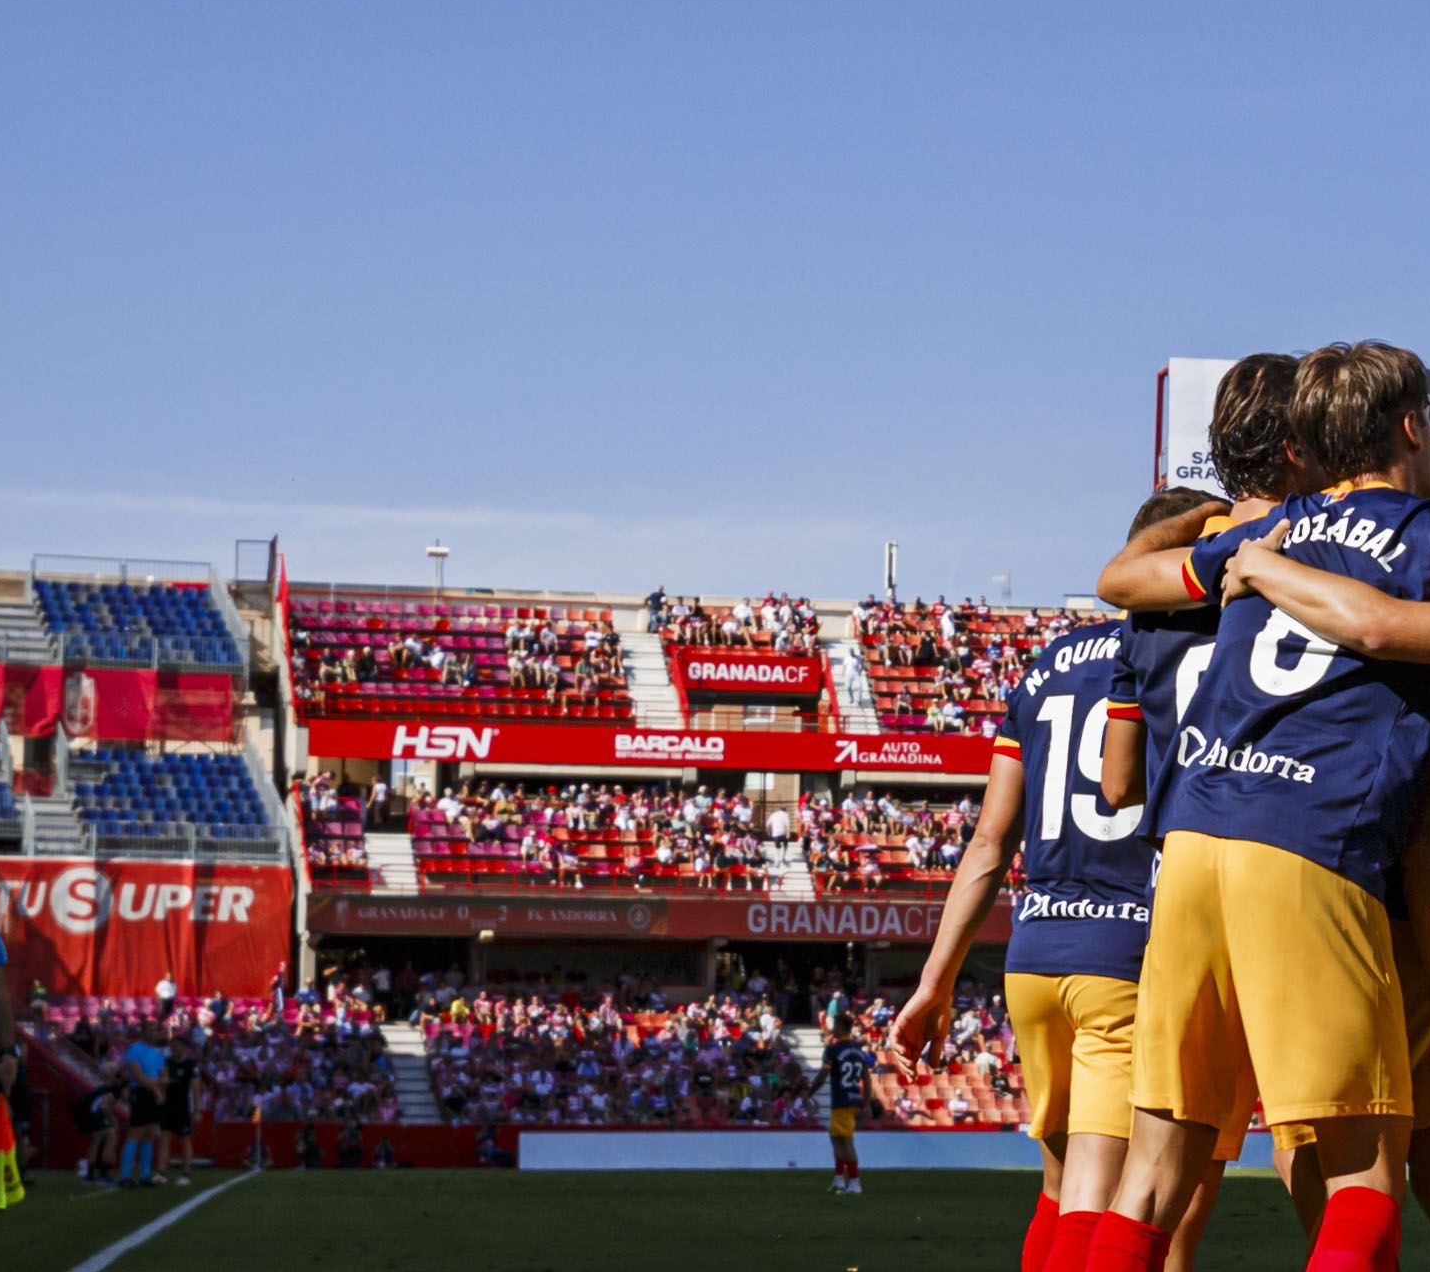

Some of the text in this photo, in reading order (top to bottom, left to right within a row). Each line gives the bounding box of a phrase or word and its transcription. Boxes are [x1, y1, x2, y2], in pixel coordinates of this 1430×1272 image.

[1025, 668, 1050, 696] N.
[391, 725, 492, 758] HSN
[615, 734, 724, 752] BARCALO
[881, 741, 920, 753] AUTO
[858, 752, 943, 764] GRANADINA
[1036, 695, 1145, 842] 19
[50, 866, 255, 935] SUPER
